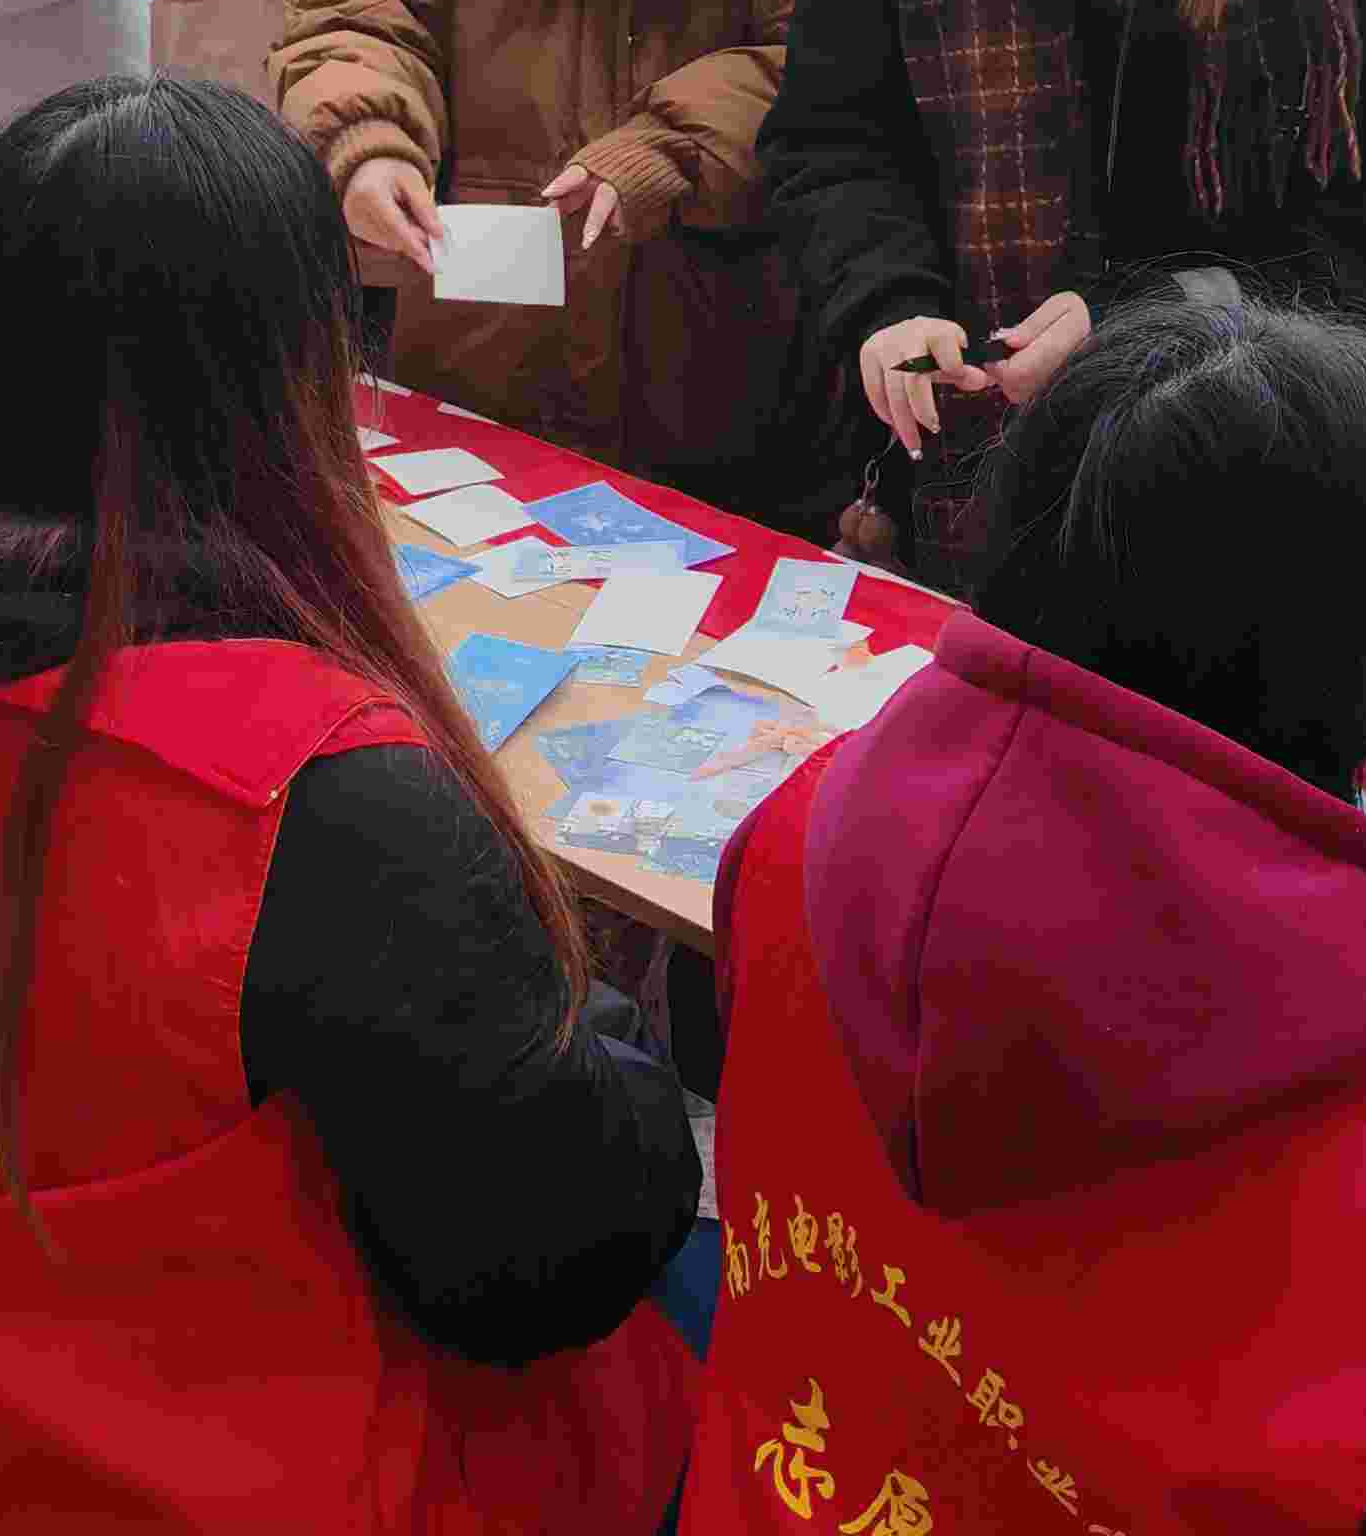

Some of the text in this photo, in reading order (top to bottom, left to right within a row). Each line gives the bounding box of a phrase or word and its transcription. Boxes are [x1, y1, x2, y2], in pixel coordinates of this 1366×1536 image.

[723, 1192, 1129, 1536] 南充电影工业职业
